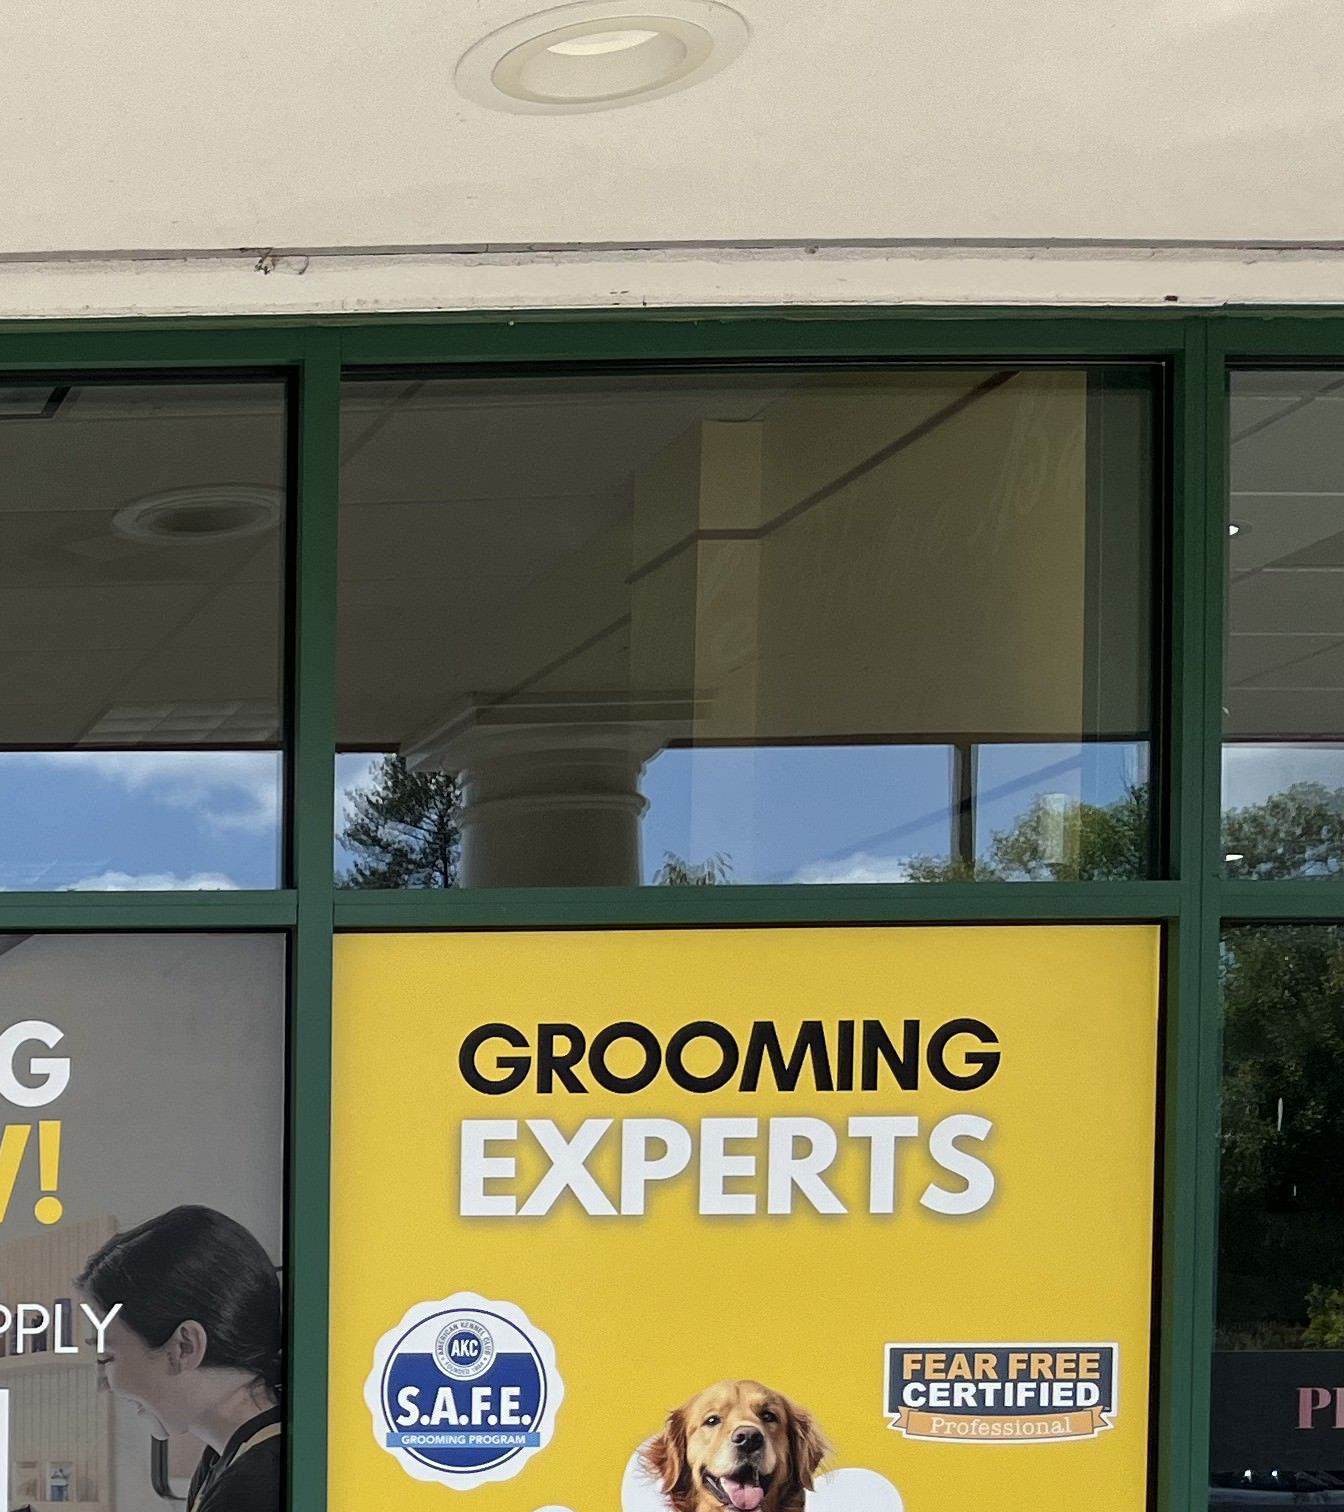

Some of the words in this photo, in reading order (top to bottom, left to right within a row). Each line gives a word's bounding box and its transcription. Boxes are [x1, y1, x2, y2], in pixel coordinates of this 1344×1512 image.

[459, 1018, 1000, 1095] GROOMING
[460, 1114, 994, 1216] EXPERTS
[460, 1322, 486, 1335] KENNEL
[451, 1340, 478, 1357] AKC
[902, 1353, 998, 1380] FEAR
[1009, 1353, 1100, 1380] FREE
[397, 1386, 532, 1426] S.A.F.E.
[902, 1382, 1100, 1407] CERTIFIED
[931, 1417, 1072, 1436] Professional
[401, 1435, 465, 1445] GROOMING
[469, 1435, 526, 1444] PROGRAM
